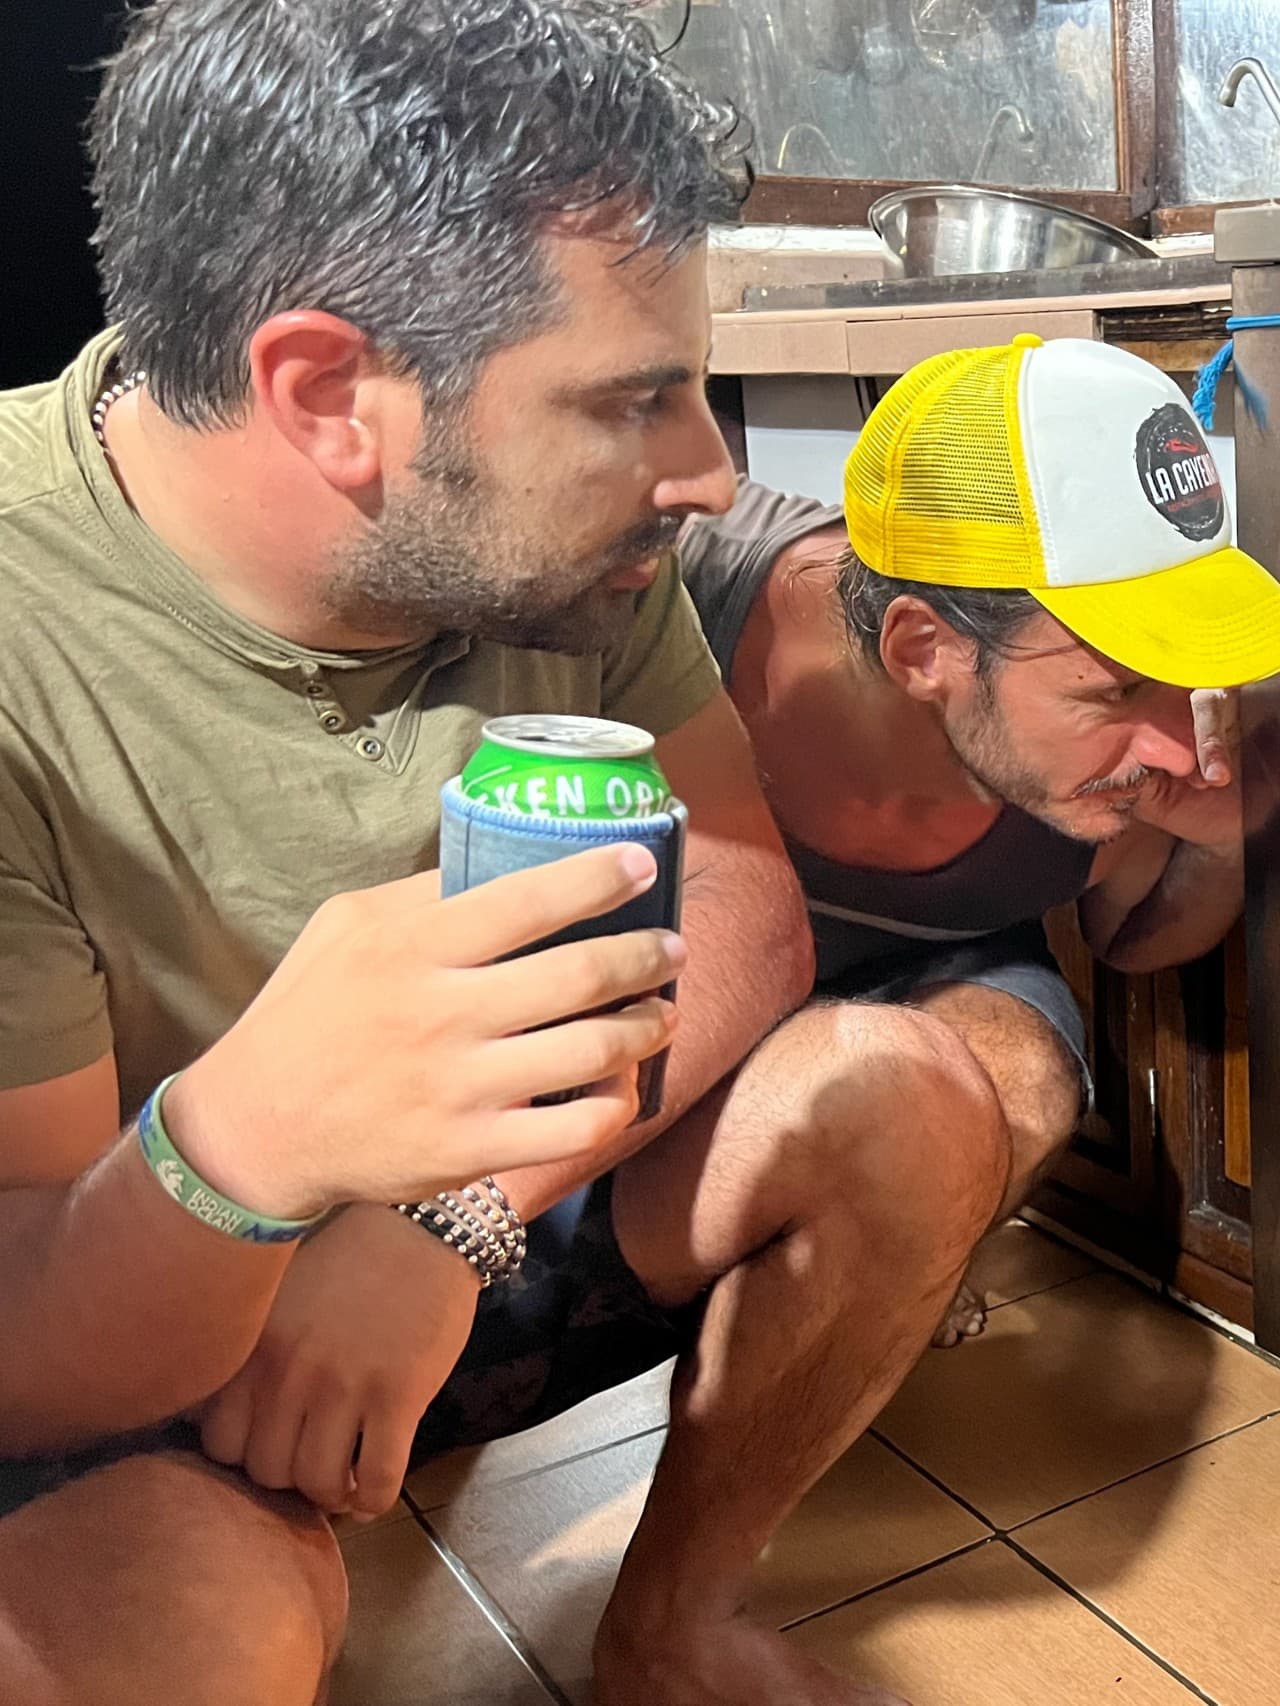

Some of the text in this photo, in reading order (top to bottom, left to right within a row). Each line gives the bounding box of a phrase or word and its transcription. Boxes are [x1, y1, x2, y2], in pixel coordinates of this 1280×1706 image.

[1145, 467, 1176, 504] LA
[187, 1199, 239, 1234] OCEAN
[193, 1187, 244, 1227] INDIAN
